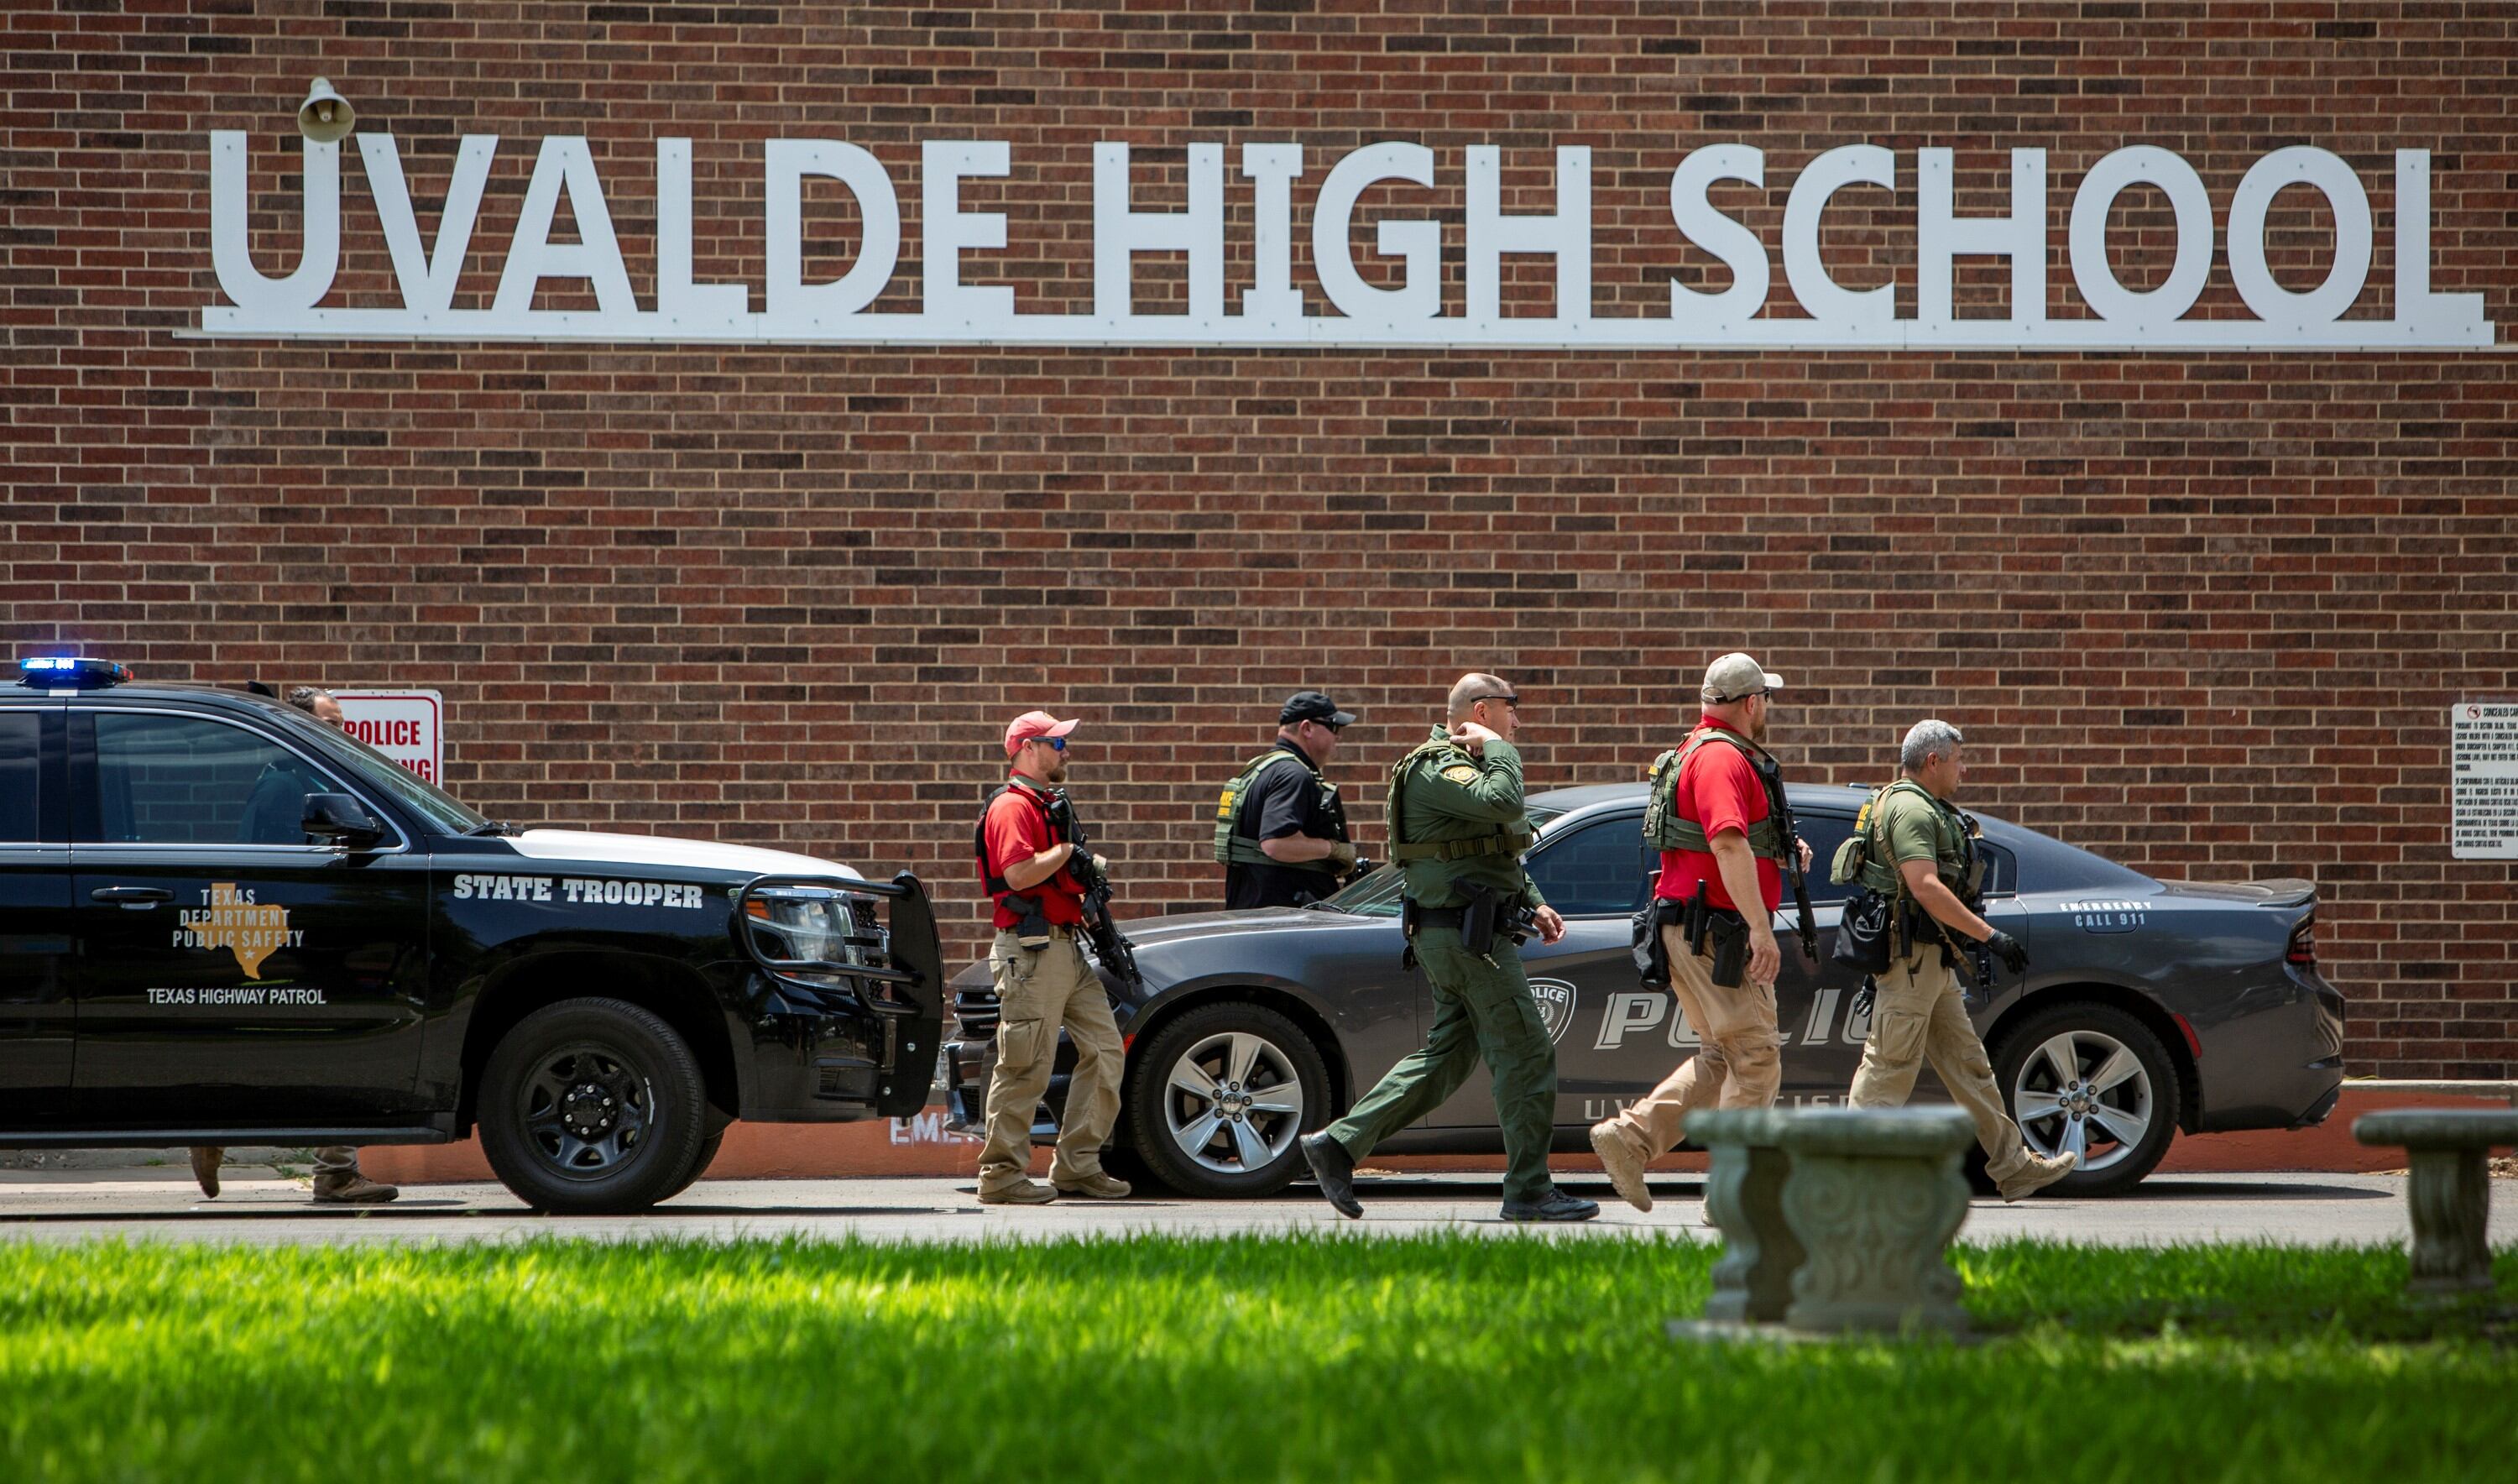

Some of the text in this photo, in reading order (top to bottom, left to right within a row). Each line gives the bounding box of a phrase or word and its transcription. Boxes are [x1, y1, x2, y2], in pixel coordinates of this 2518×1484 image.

[210, 129, 2484, 324] UVALDE HIGH SCHOOL
[344, 720, 421, 745] POLICE
[201, 889, 255, 906] TEXAS
[454, 875, 703, 908] STATE TROOPER
[2059, 901, 2152, 912] EMERGENCY
[180, 909, 290, 927] DEPARTMENT
[2075, 912, 2145, 927] CALL 911
[173, 930, 304, 948] PUBLIC SAFETY
[147, 989, 327, 1004] TEXAS HIGHWAY PATROL
